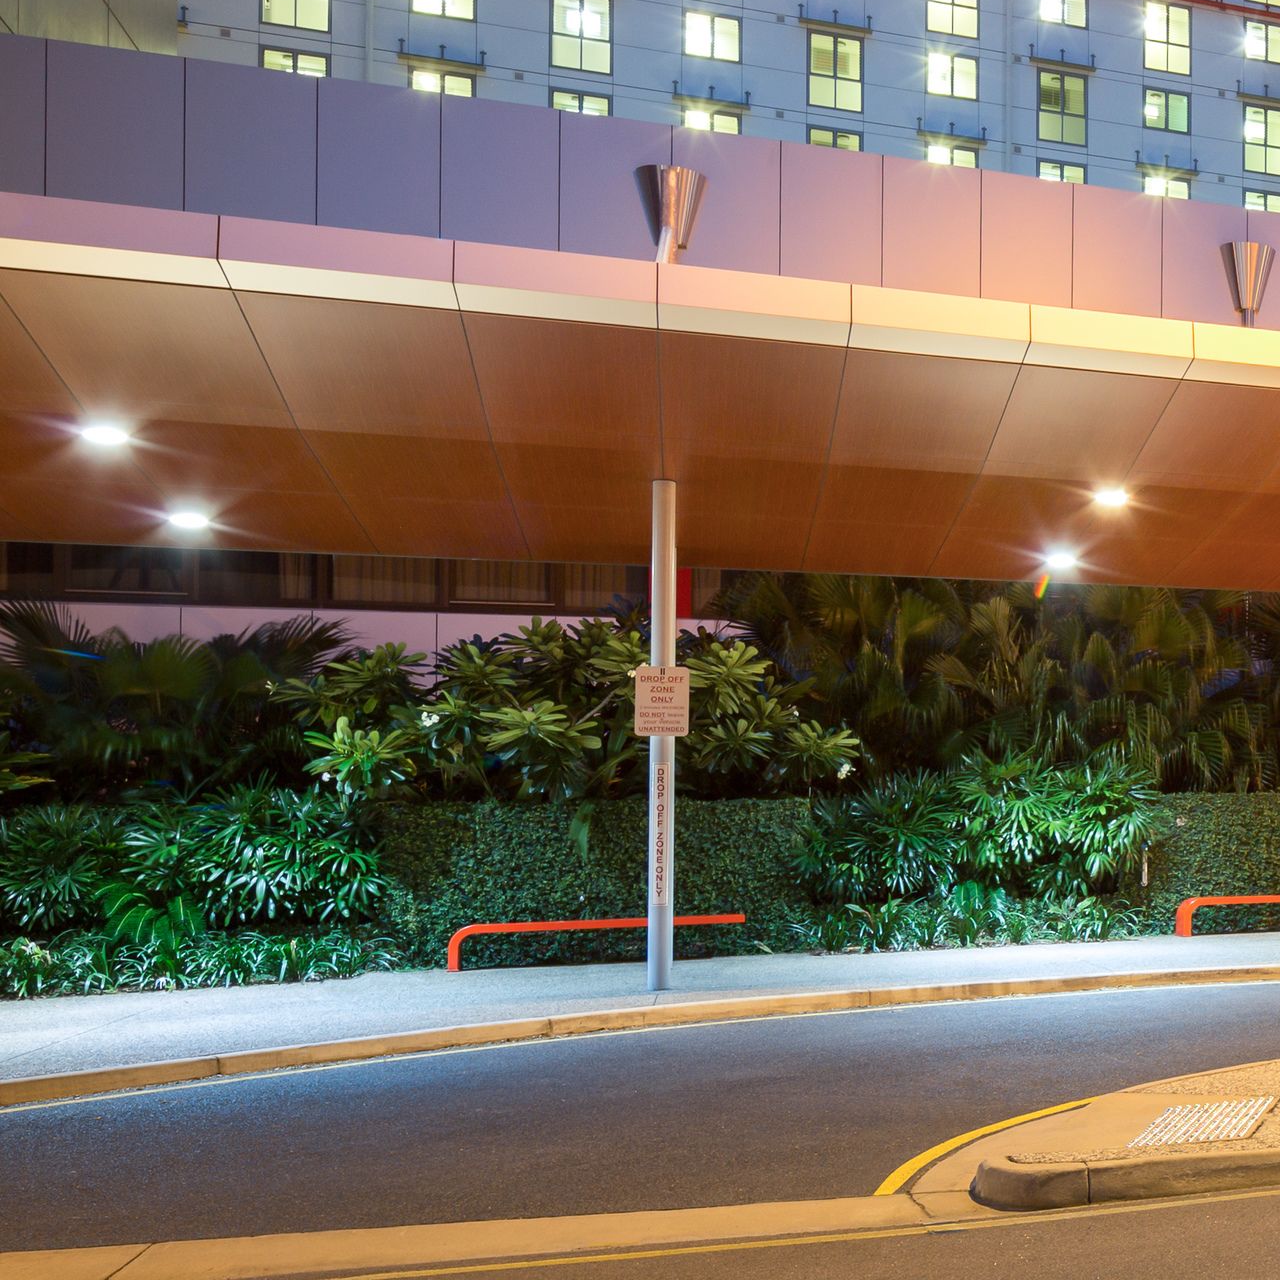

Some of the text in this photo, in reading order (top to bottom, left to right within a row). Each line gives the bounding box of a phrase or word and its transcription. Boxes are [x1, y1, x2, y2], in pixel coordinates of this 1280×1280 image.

[640, 675, 685, 683] DROP OFF
[655, 768, 665, 897] DROP OFF ZONE ONLY
